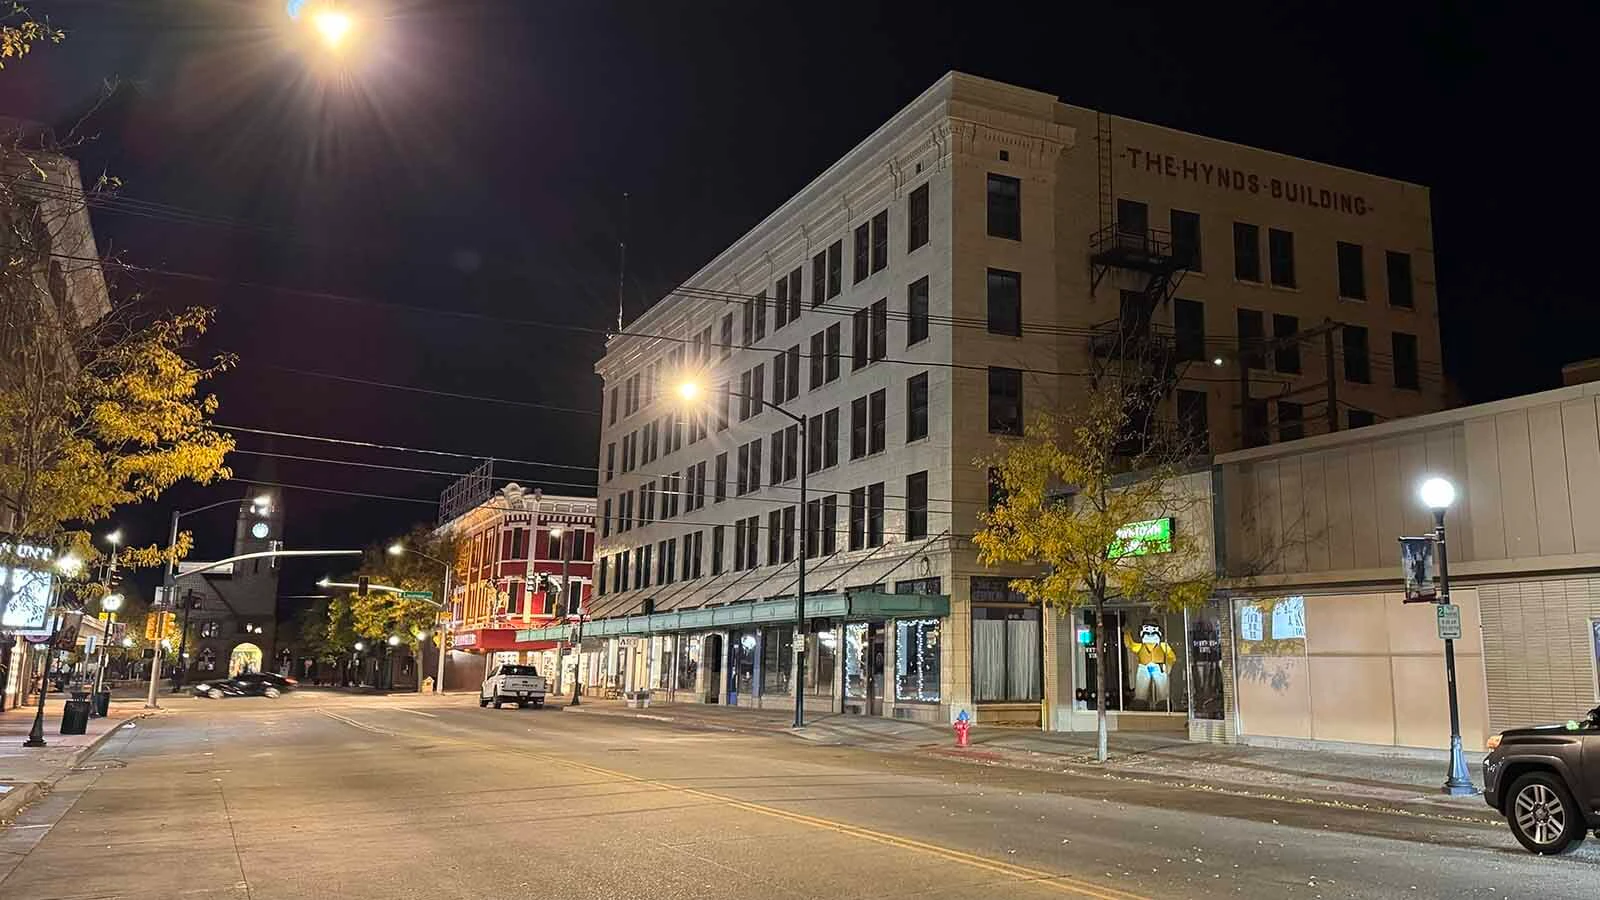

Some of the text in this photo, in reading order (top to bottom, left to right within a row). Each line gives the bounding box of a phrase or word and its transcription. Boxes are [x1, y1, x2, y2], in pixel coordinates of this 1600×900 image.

[1128, 149, 1366, 215] THE HYNDS BUILDING
